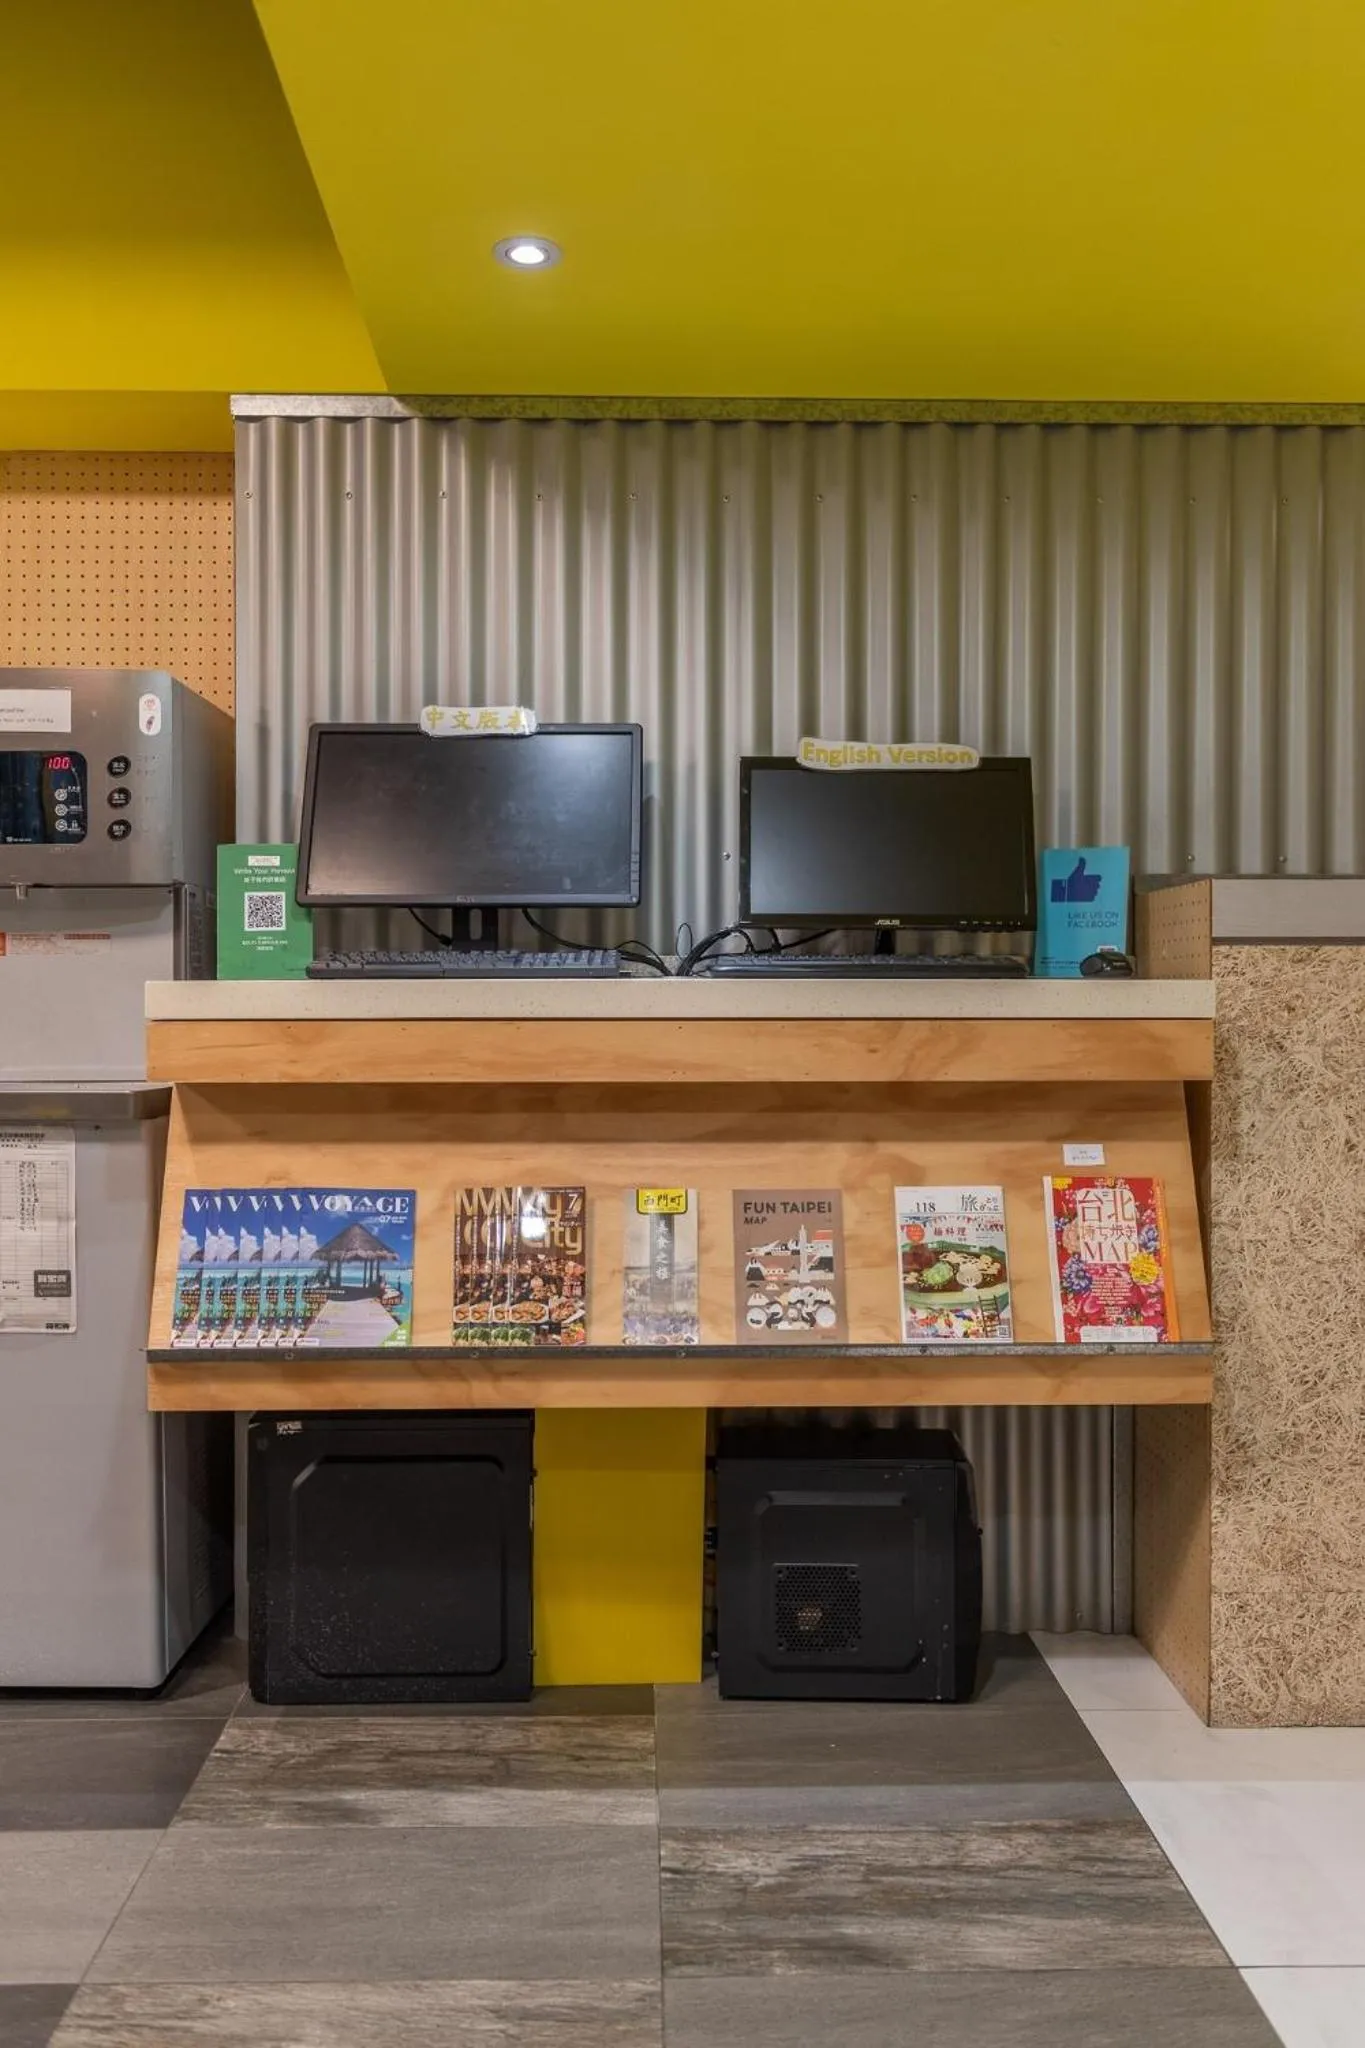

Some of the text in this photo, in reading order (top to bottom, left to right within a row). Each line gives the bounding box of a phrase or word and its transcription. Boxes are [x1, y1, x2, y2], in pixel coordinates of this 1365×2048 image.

[803, 741, 973, 767] English Version
[48, 756, 70, 770] 100
[1068, 912, 1087, 920] LIKE
[1105, 911, 1119, 919] ON
[1068, 920, 1118, 928] FACEBOOK
[309, 1194, 409, 1214] VOYAGE
[568, 1194, 578, 1209] 7
[643, 1194, 683, 1208] 西門町
[743, 1202, 832, 1214] FUN TAIPEI
[916, 1202, 936, 1213] 118
[1078, 1190, 1134, 1223] 台北
[743, 1217, 767, 1225] MAP
[1084, 1242, 1138, 1262] MAP
